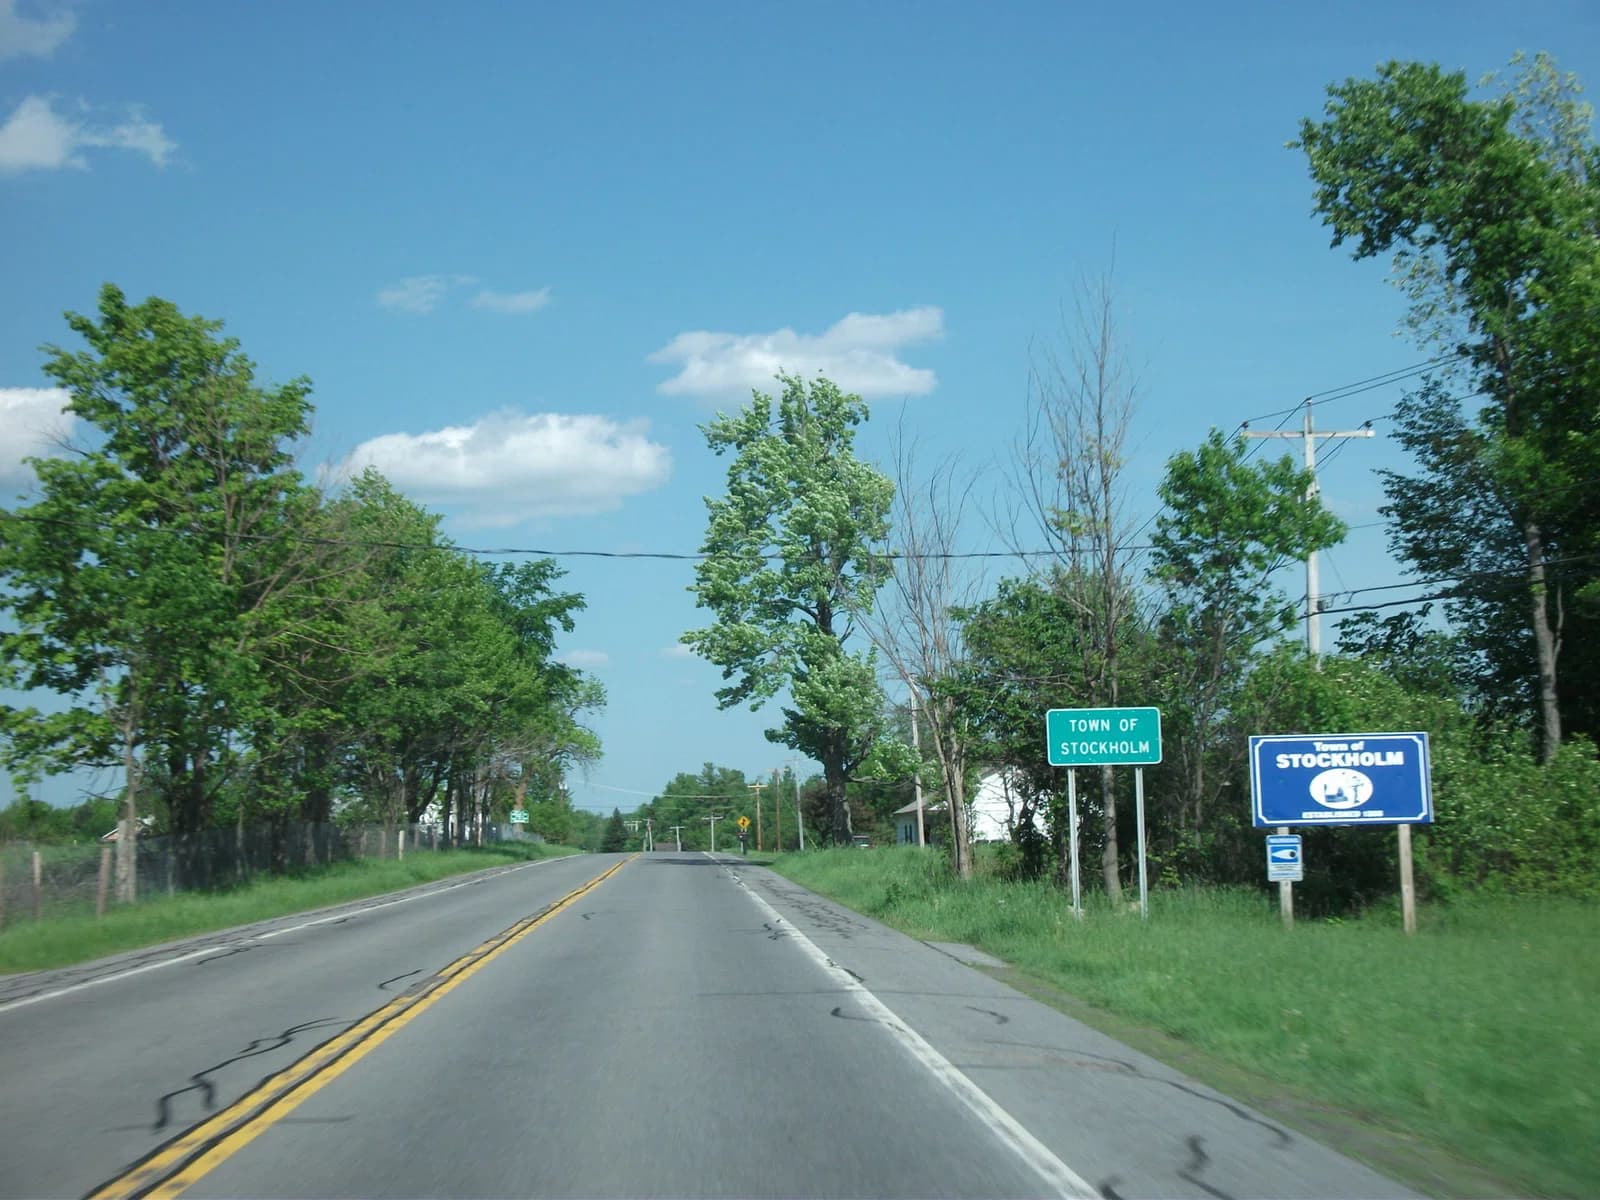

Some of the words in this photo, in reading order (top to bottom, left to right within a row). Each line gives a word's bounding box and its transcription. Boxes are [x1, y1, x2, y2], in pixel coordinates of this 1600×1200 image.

[1069, 719, 1110, 732] TOWN
[1119, 718, 1139, 731] OF
[1061, 741, 1150, 755] STOCKHOLM
[1313, 742, 1348, 752] Town
[1350, 741, 1365, 751] of
[1276, 751, 1404, 768] STOCKHOLM
